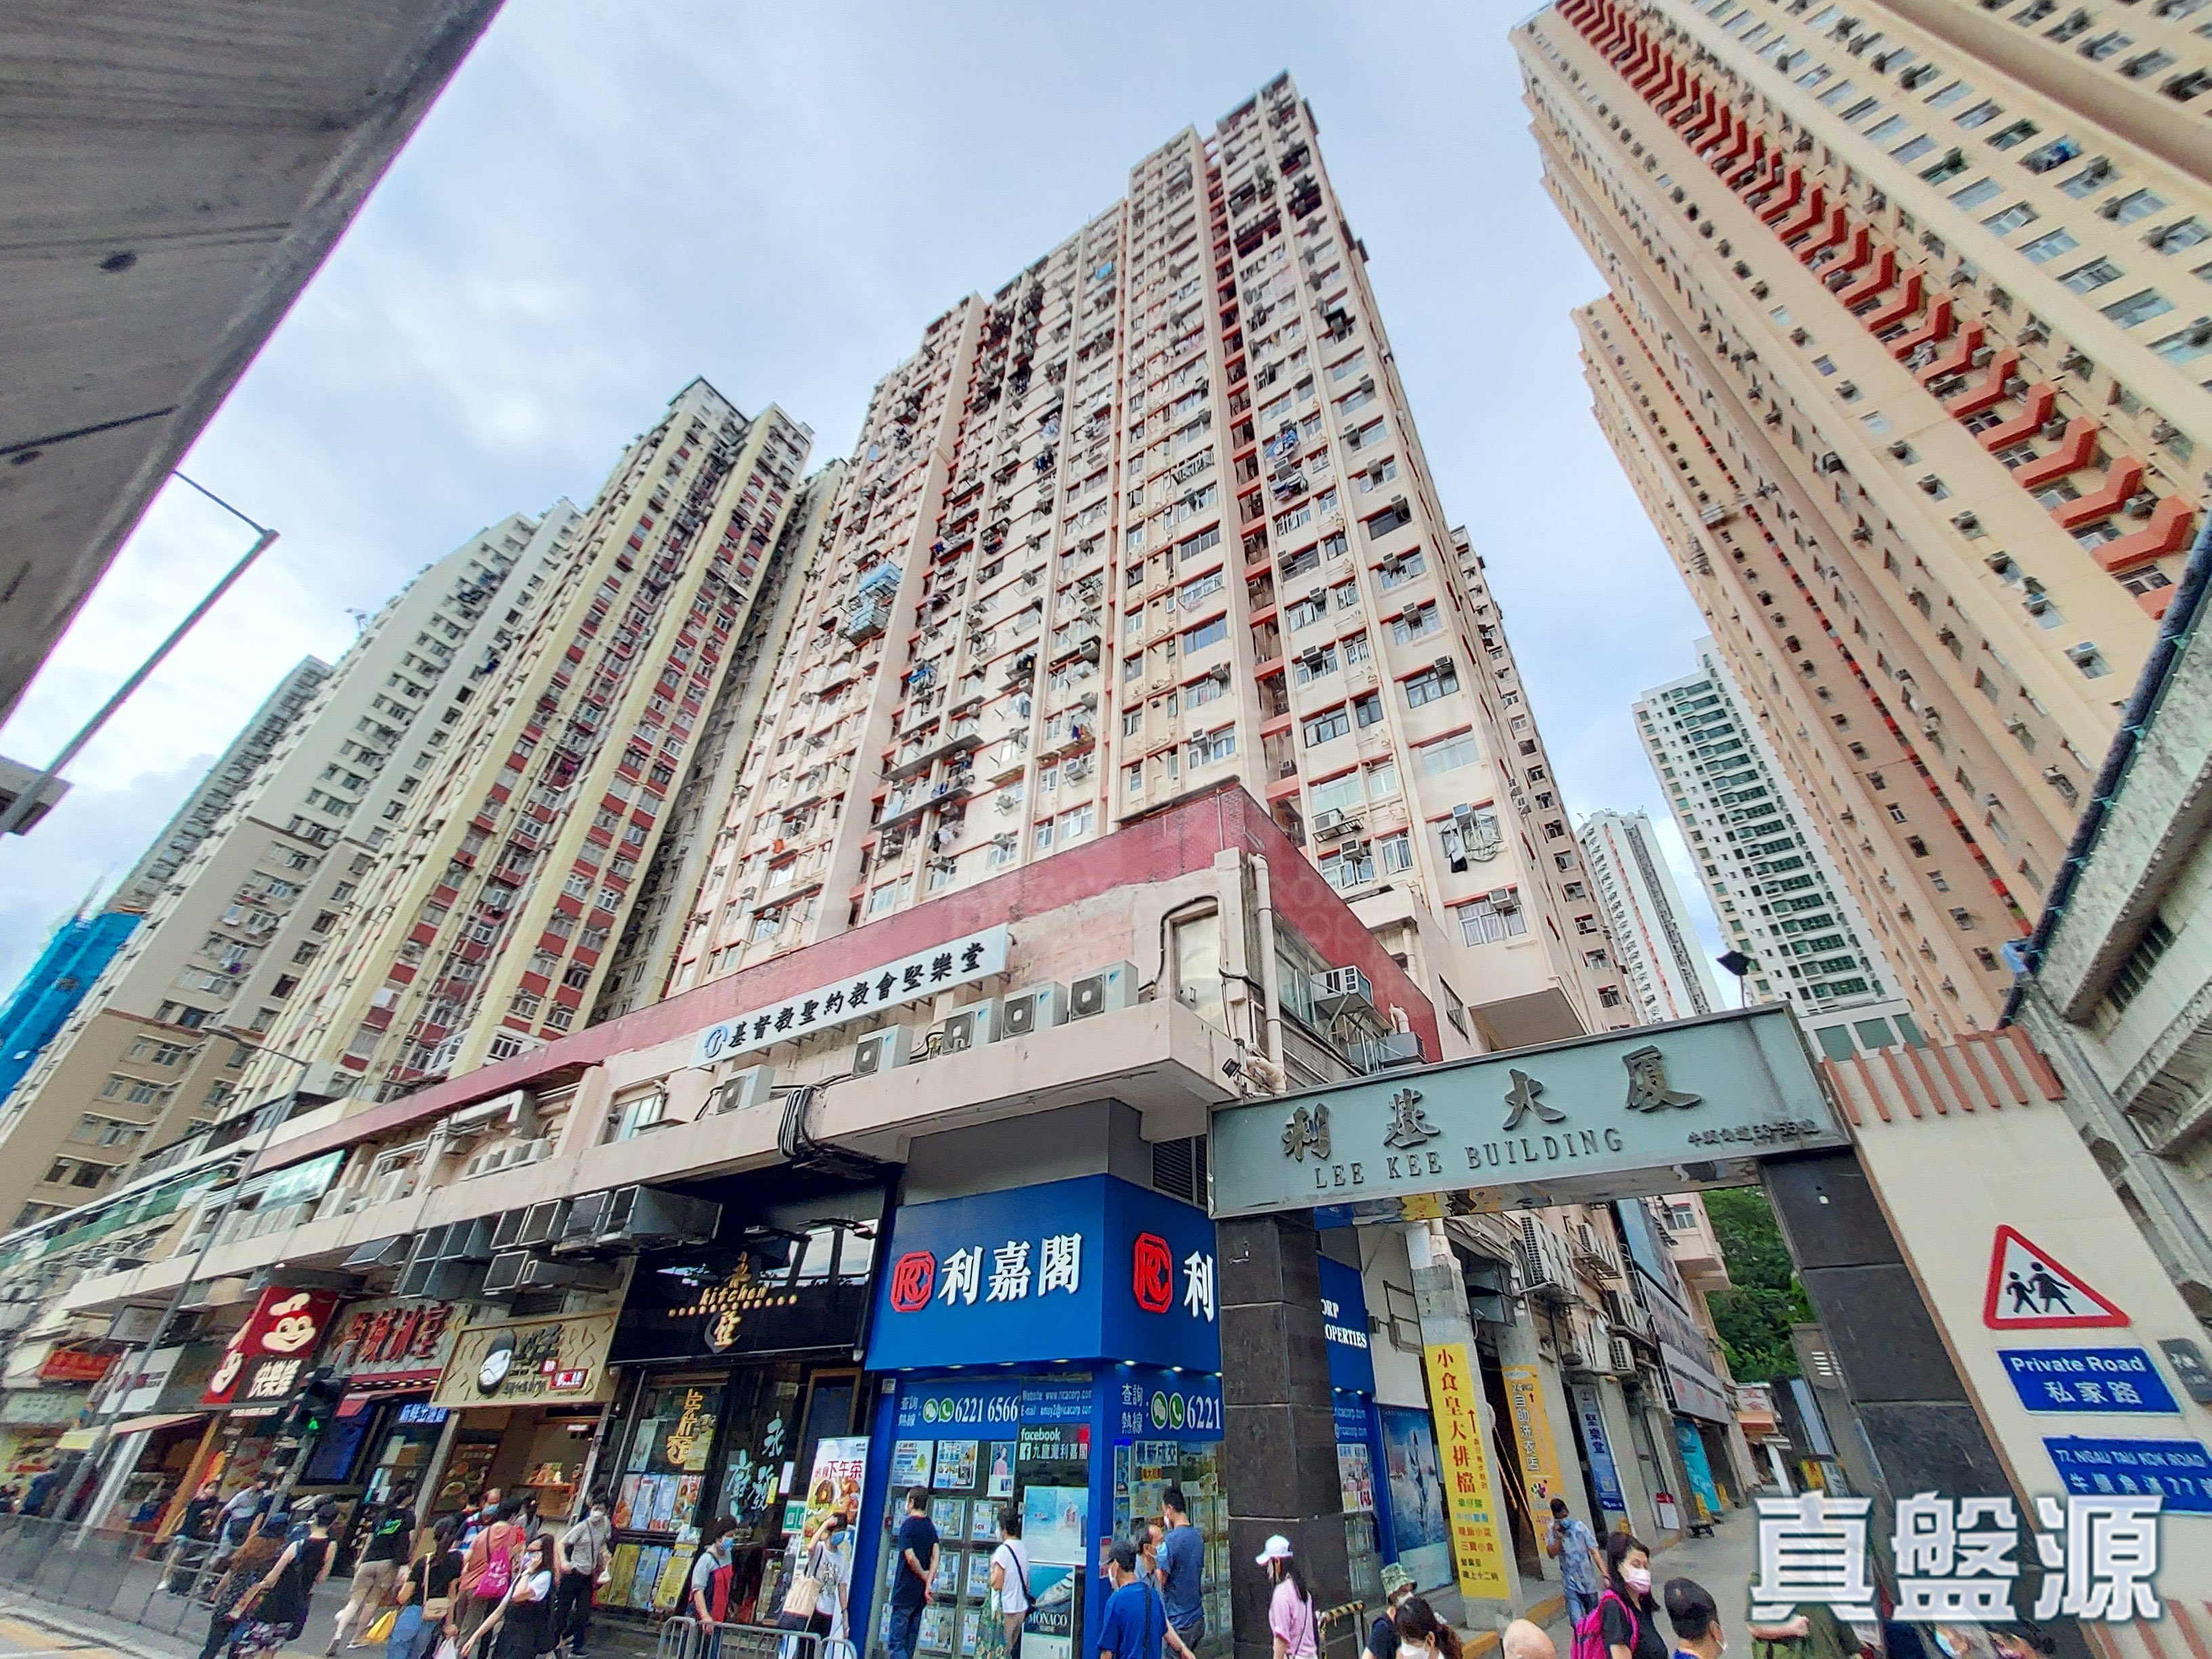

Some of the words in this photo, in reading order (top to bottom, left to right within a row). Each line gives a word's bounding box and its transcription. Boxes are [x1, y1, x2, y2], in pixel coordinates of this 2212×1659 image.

[727, 943, 985, 1048] 基督教聖約教會堅樂堂
[1281, 1044, 1701, 1162] 利基大廈
[1315, 1162, 1364, 1188] LEE
[1386, 1151, 1442, 1179] KEE
[1465, 1128, 1622, 1168] BUILDING
[937, 1233, 1082, 1306] 利嘉閣
[699, 1283, 770, 1306] kitchen
[1183, 1251, 1214, 1322] 利
[1323, 1325, 1367, 1349] OPERTIES
[2009, 1356, 2087, 1372] Private
[2085, 1355, 2147, 1372] Road
[2043, 1380, 2144, 1405] 私家路
[955, 1397, 983, 1423] 6221
[987, 1395, 1020, 1423] 6566
[1187, 1395, 1221, 1431] 6221
[1437, 1348, 1476, 1494] 小食皇大排檔
[1021, 1427, 1061, 1441] facebook
[827, 1460, 863, 1479] 下午茶
[1028, 1612, 1068, 1627] MONACO
